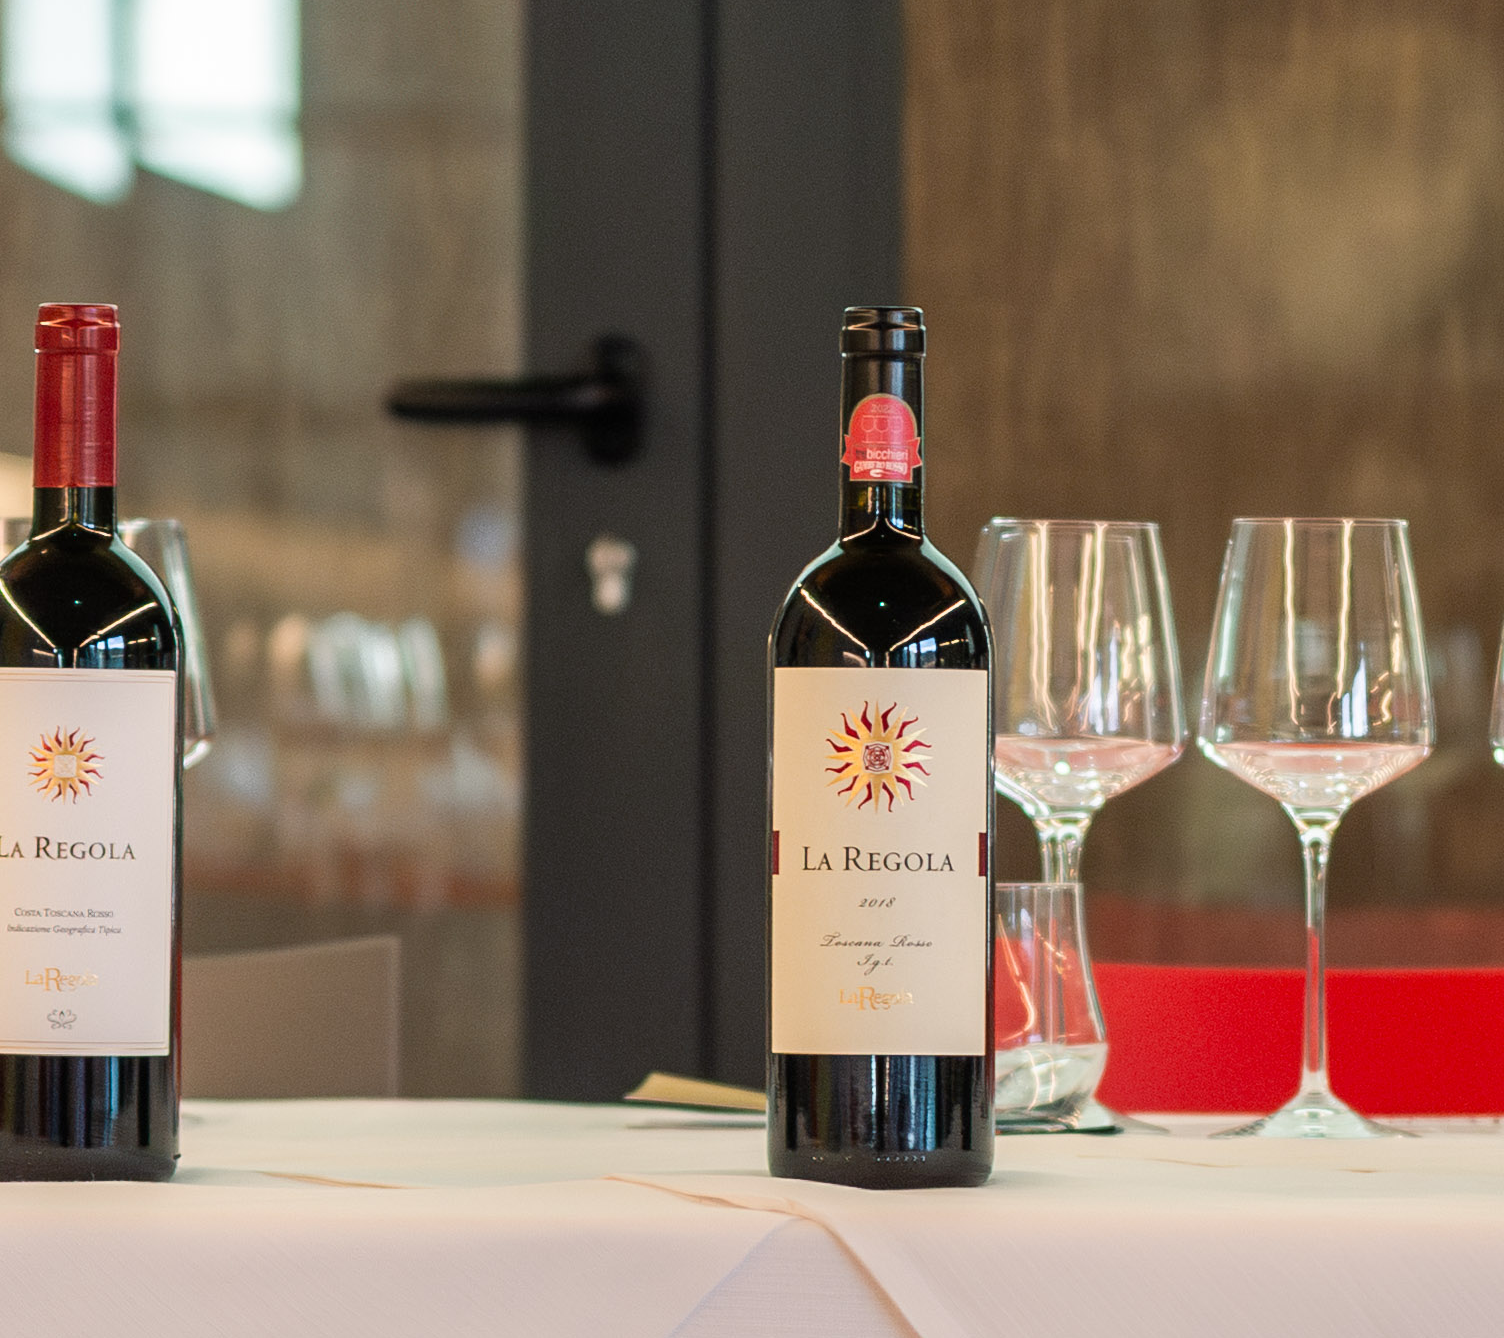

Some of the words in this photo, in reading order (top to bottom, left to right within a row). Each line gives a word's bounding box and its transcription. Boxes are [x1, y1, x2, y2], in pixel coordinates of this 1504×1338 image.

[35, 836, 136, 860] REGOLA
[802, 846, 832, 871] LA
[843, 846, 955, 872] REGOLA
[858, 897, 897, 908] 2018
[820, 931, 883, 947] Toscana
[889, 933, 933, 947] Rosso
